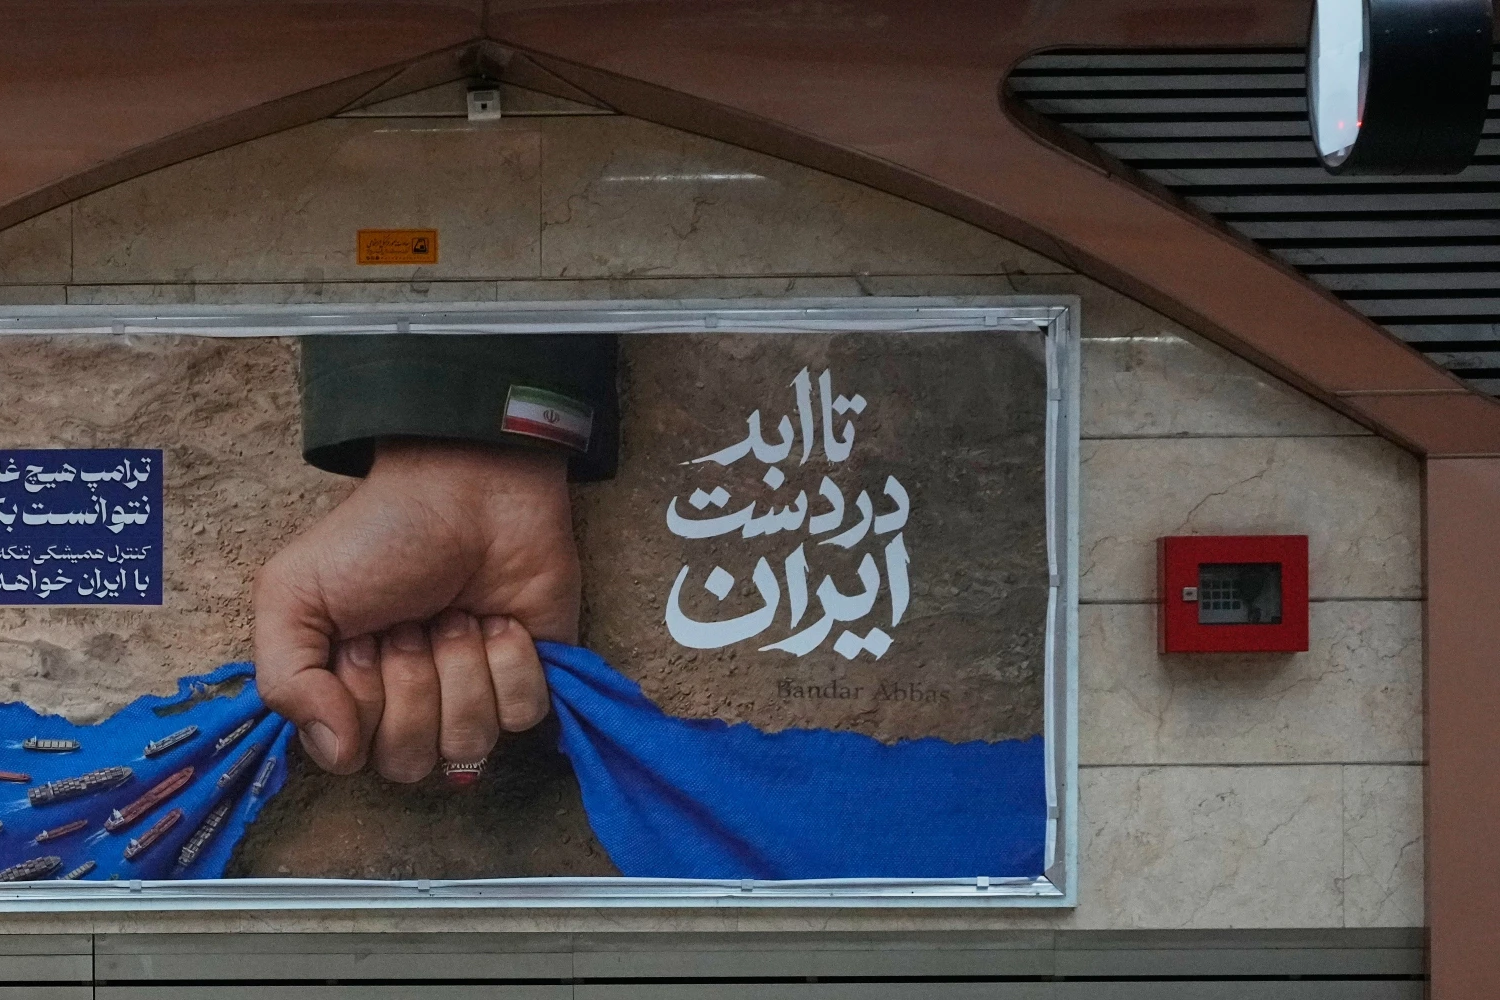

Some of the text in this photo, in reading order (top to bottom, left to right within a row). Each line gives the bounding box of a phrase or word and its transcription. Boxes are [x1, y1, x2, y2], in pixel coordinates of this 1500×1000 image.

[678, 366, 868, 491] تا ابد
[24, 462, 77, 493] هیچ
[80, 456, 152, 492] ترامپ
[22, 494, 151, 534] نتوانست
[106, 544, 152, 564] کنترل
[77, 567, 127, 598] ایران
[134, 568, 150, 597] با
[665, 531, 911, 661] ایران
[776, 678, 951, 702] Bandar Abbas
